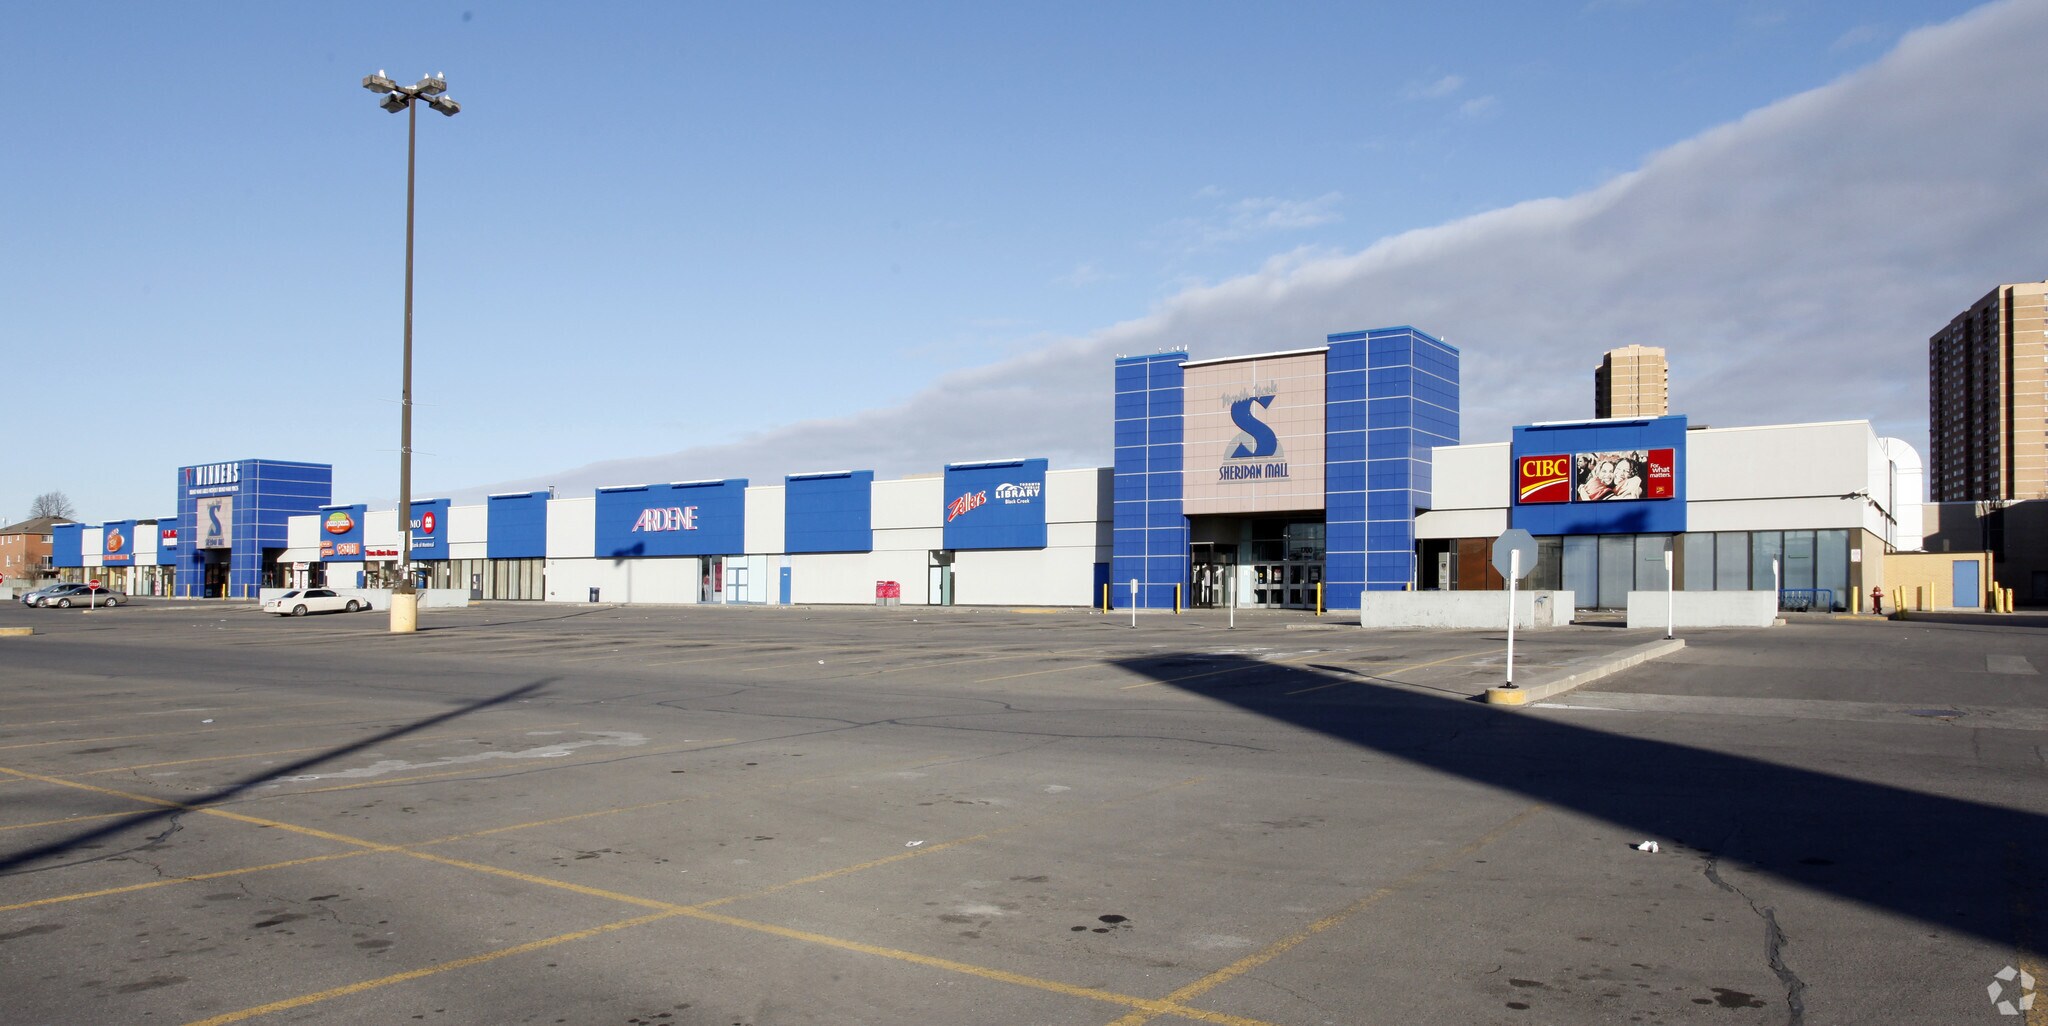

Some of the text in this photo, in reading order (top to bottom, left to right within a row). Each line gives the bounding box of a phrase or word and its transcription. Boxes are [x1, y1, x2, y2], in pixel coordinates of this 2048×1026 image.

[196, 462, 239, 486] WINNERS
[1218, 462, 1289, 481] SHERIDAN MALL
[1522, 458, 1568, 478] CIBC
[995, 489, 1040, 498] LIBRARY
[947, 490, 987, 522] Zellers
[410, 519, 421, 529] MO
[631, 505, 698, 532] ARDENE
